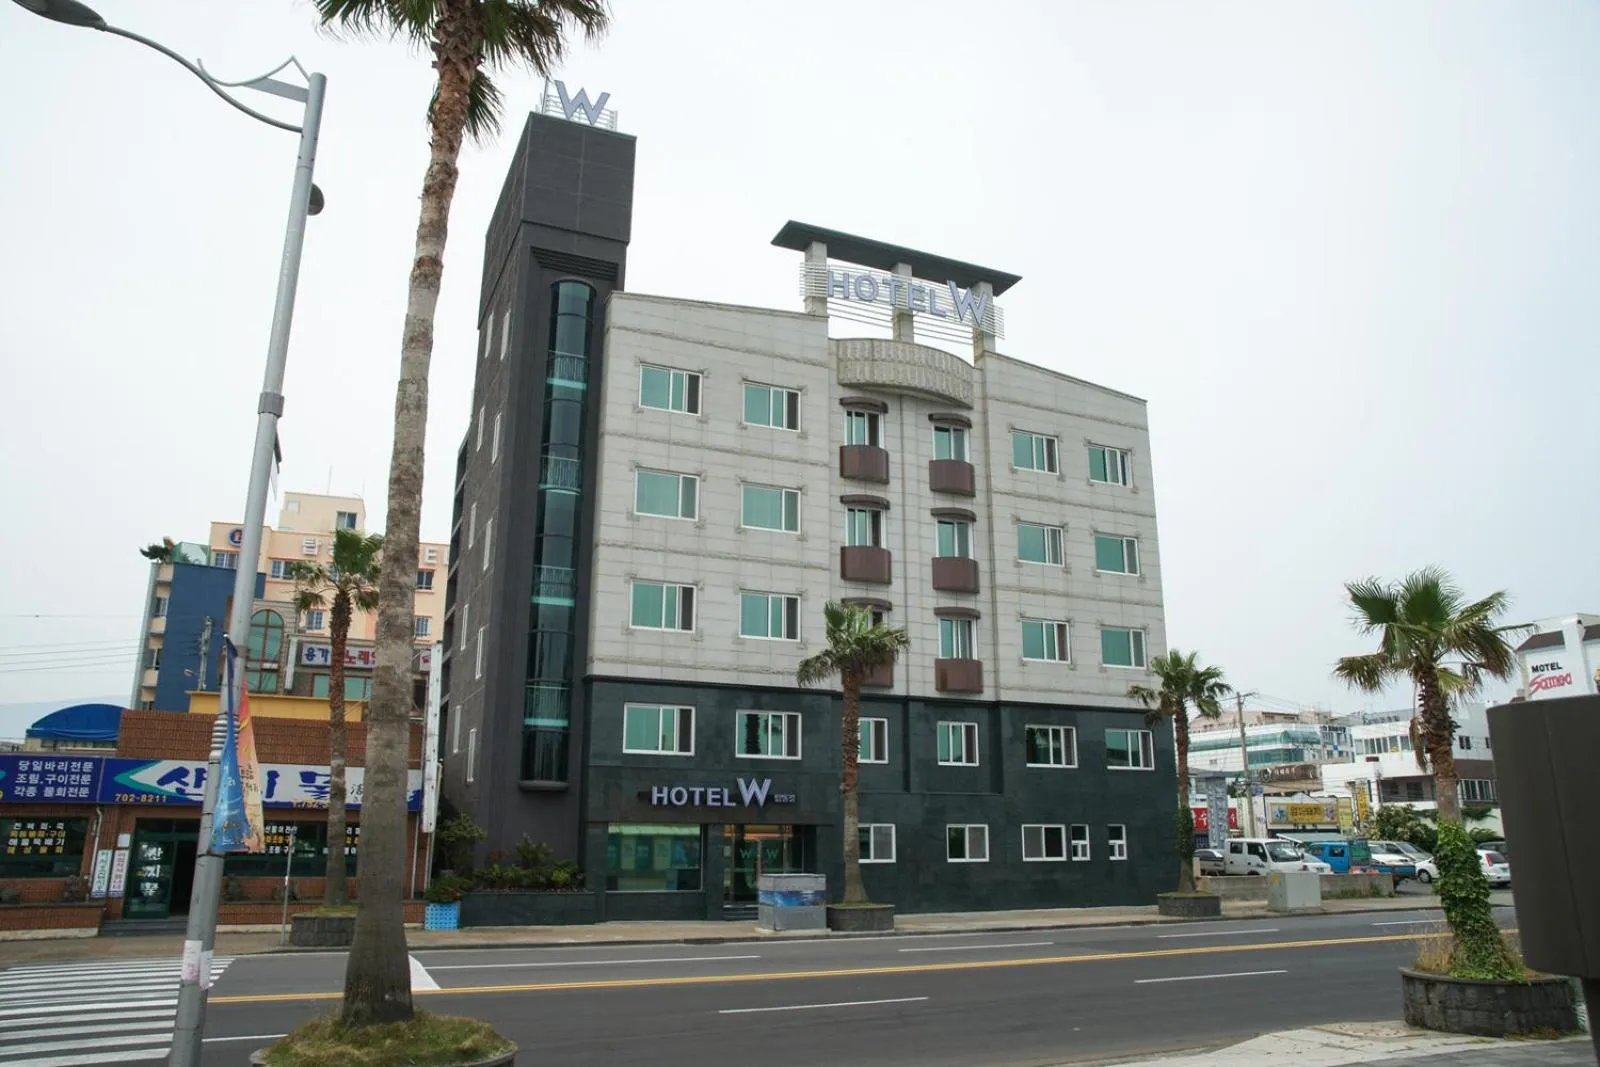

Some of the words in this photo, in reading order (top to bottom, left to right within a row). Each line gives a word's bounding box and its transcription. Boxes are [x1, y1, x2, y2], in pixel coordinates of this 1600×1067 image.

[554, 79, 611, 126] W
[827, 270, 947, 318] HOTEL
[947, 279, 988, 327] W
[1531, 662, 1563, 673] MOTEL
[114, 793, 167, 804] 702-8211
[651, 785, 737, 807] HOTEL
[736, 777, 772, 808] W
